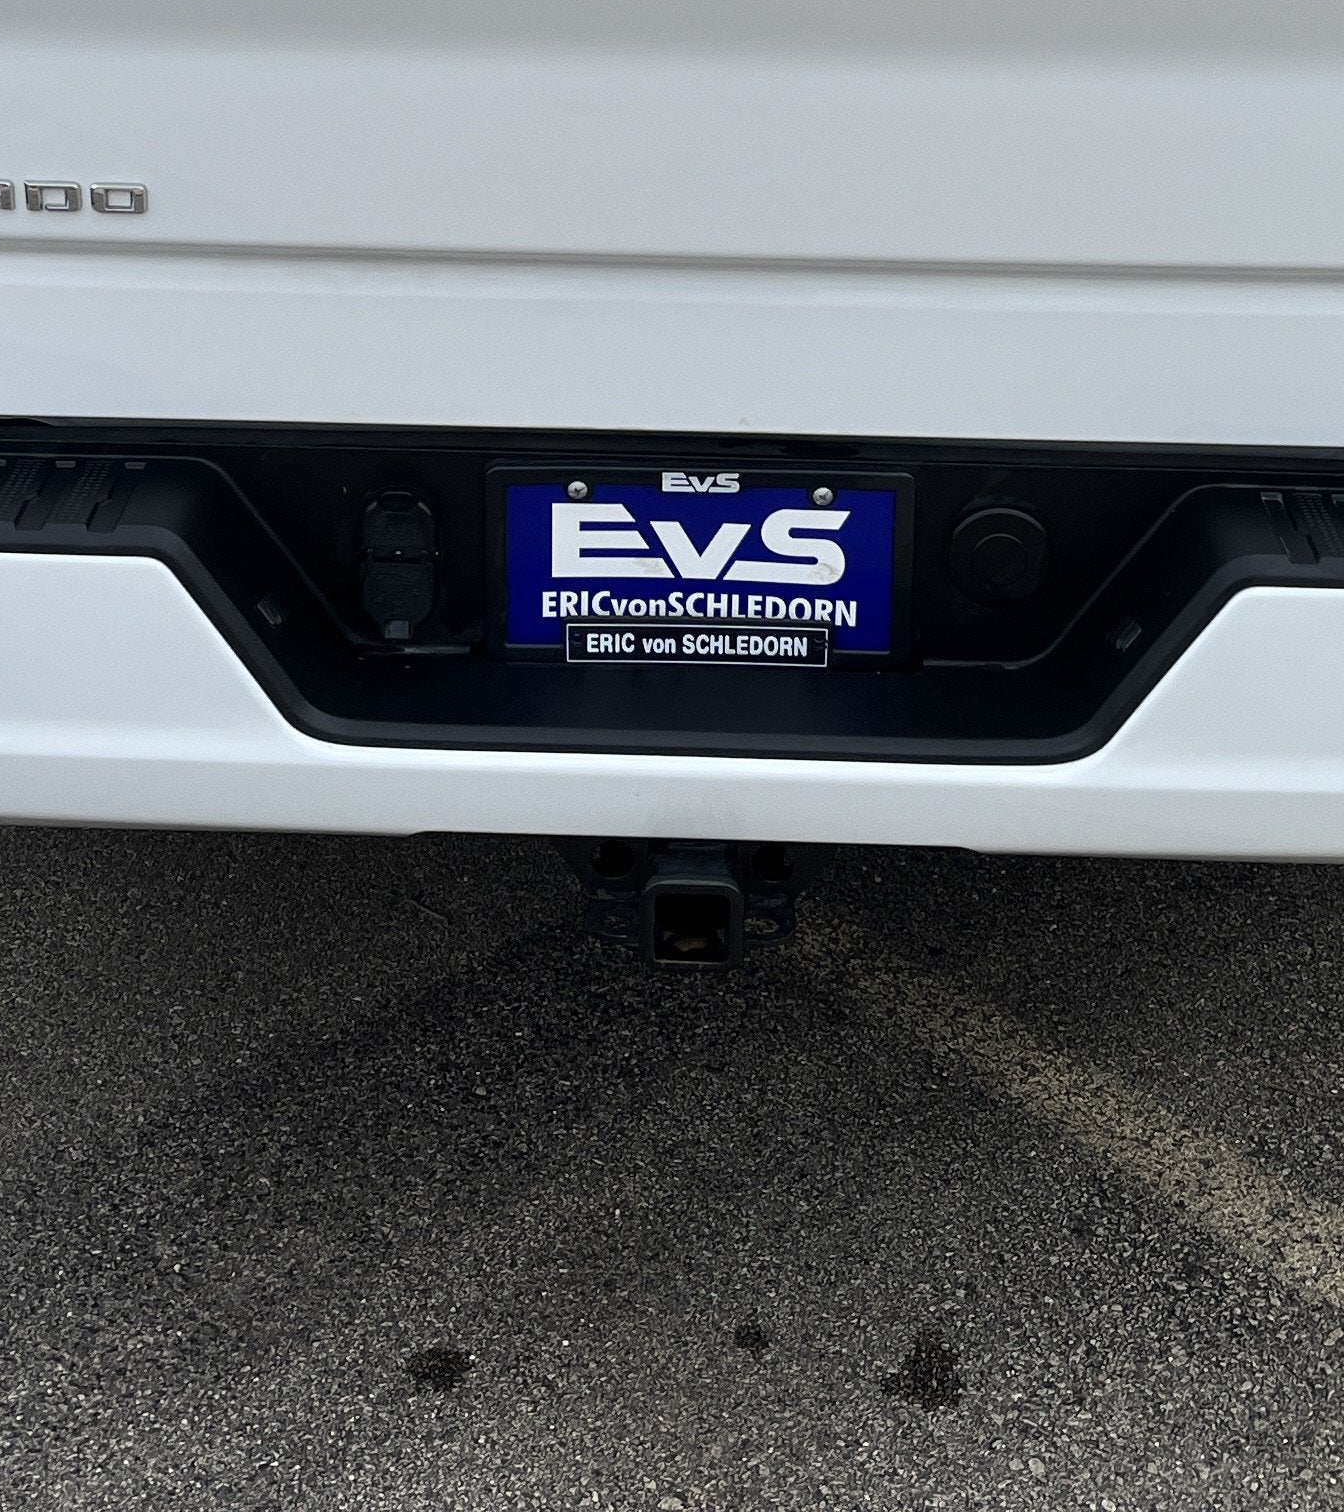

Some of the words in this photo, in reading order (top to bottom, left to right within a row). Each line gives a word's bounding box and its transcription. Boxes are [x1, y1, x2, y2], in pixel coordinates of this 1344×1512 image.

[586, 632, 635, 654] ERIC
[642, 637, 677, 655] von
[682, 633, 809, 657] SCHLEDORN
